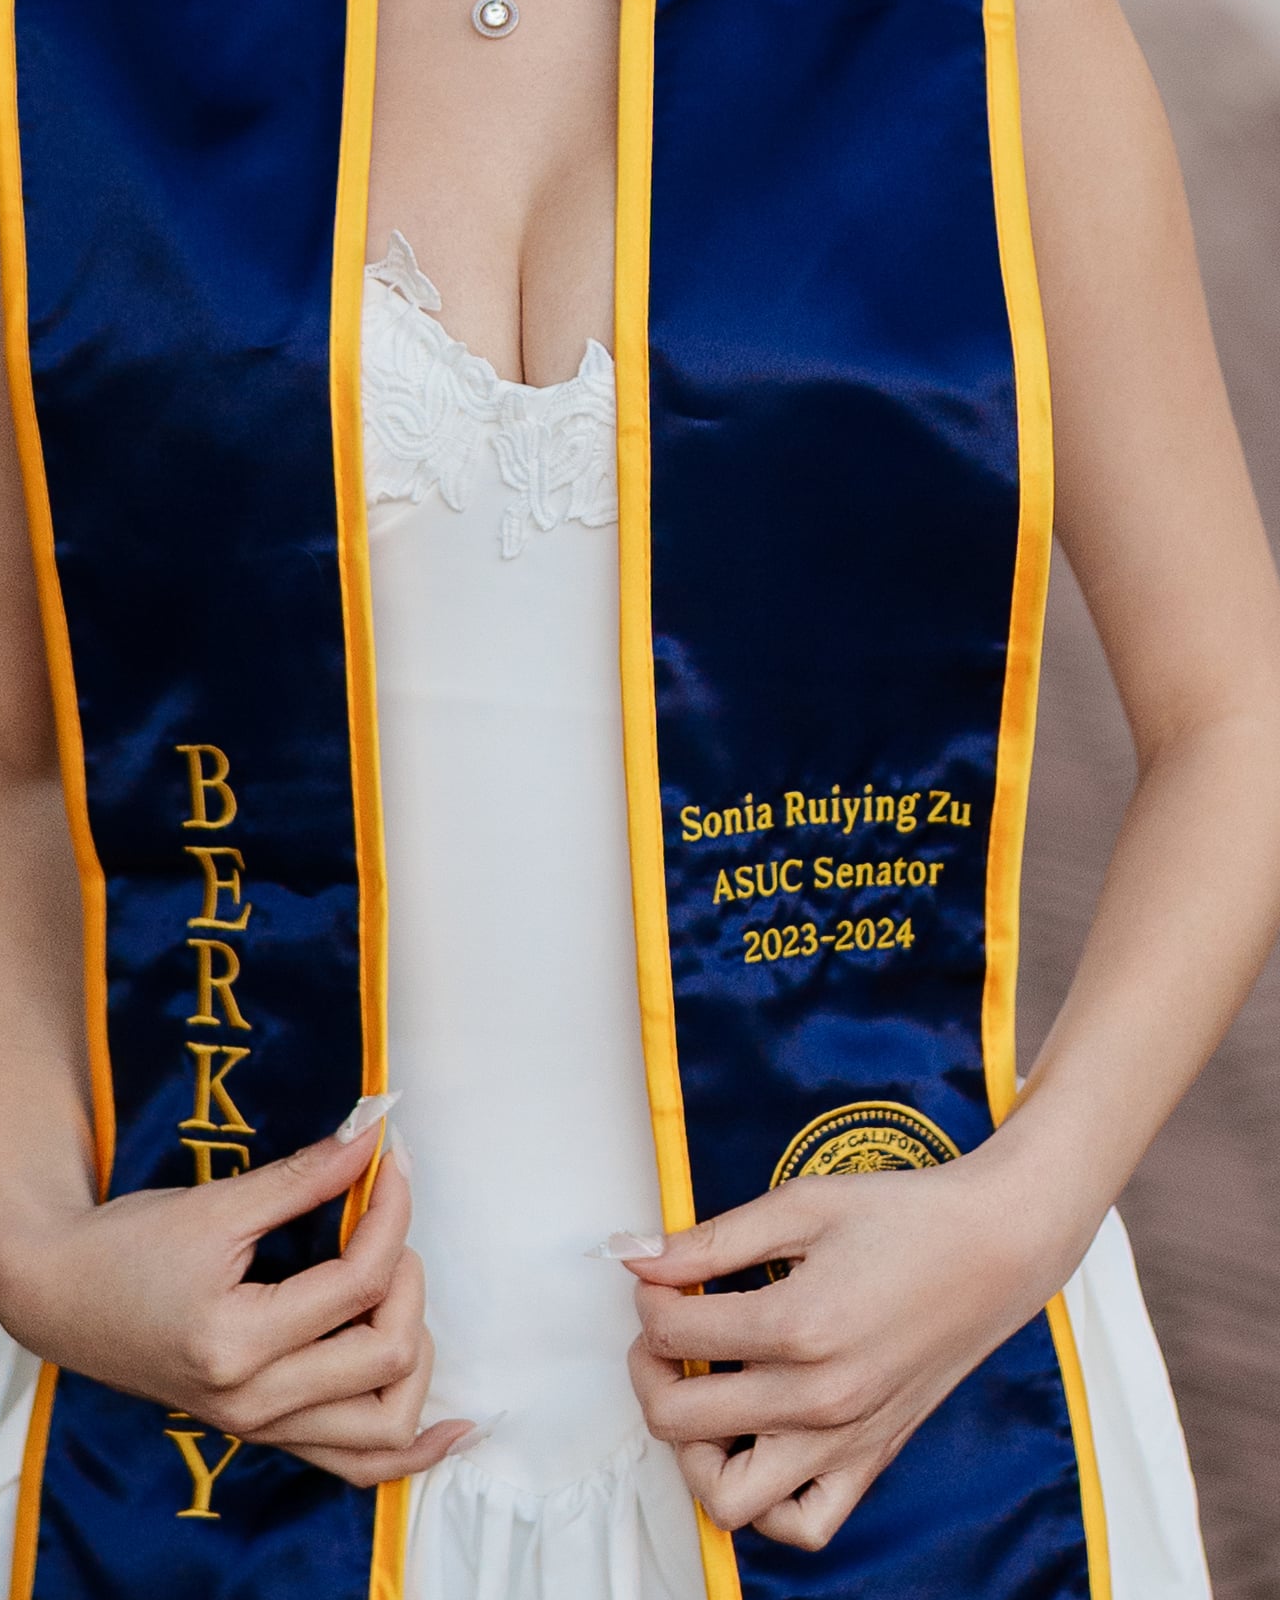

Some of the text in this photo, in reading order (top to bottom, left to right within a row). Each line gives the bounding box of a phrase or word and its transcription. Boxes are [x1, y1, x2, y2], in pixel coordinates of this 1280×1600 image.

[680, 783, 972, 842] Sonia Ruiying Zu
[713, 856, 944, 904] ASUC Senator
[742, 917, 916, 963] 2023-2024
